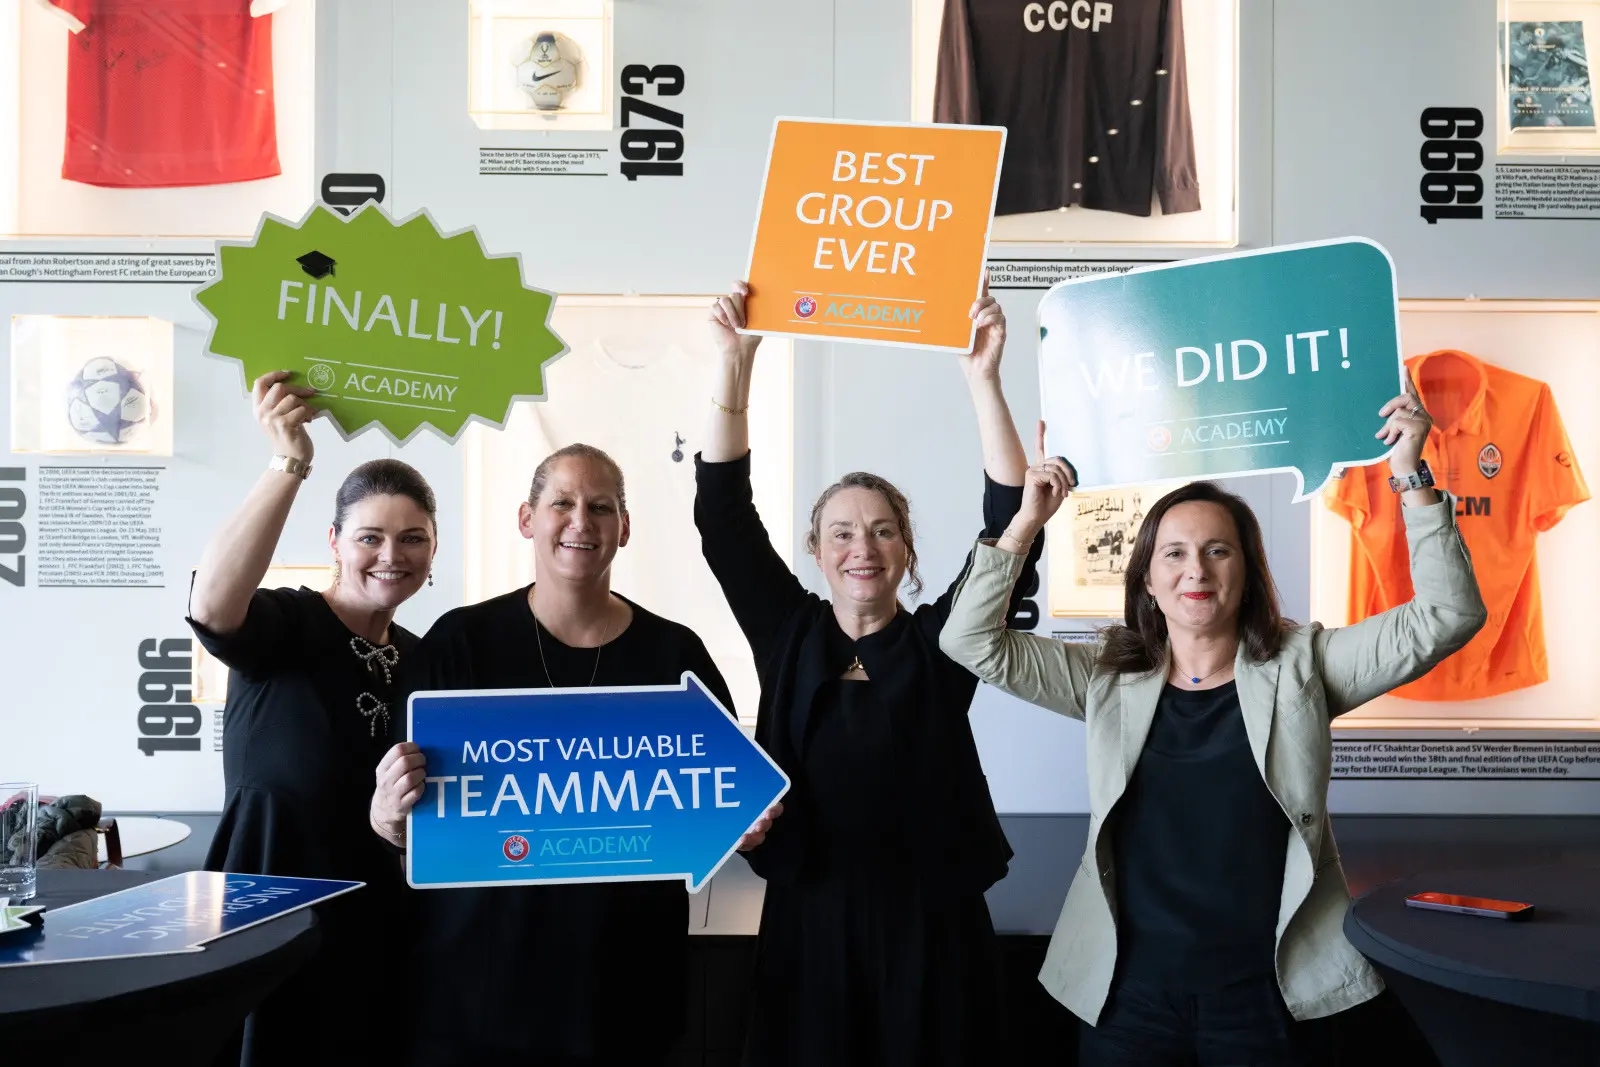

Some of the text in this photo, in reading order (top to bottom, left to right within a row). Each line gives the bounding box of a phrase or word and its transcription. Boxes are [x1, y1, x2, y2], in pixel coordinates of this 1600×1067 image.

[620, 64, 685, 181] 1973
[832, 150, 935, 186] BEST
[1420, 107, 1484, 224] 1999
[795, 192, 953, 232] GROUP
[0, 257, 11, 265] oal
[12, 257, 32, 265] from
[117, 258, 140, 267] string
[141, 258, 149, 266] of
[150, 258, 171, 268] great
[195, 259, 204, 268] by
[813, 237, 916, 276] EVER
[1006, 265, 1063, 274] Championship
[9, 268, 42, 277] Clough's
[44, 268, 92, 277] Nottingham
[169, 269, 207, 278] European
[277, 279, 503, 350] FINALLY!
[824, 302, 925, 324] ACADEMY
[1080, 351, 1159, 399] WE
[1175, 338, 1268, 388] DID
[344, 372, 458, 403] ACADEMY
[1181, 417, 1288, 446] ACADEMY
[1456, 496, 1491, 516] CM
[138, 638, 202, 756] 1996
[461, 734, 706, 764] MOST VALUABLE
[1335, 755, 1353, 763] 25th
[1355, 755, 1371, 763] club
[1373, 755, 1397, 763] would
[1398, 755, 1412, 763] win
[1413, 755, 1427, 763] the
[1429, 755, 1447, 763] 38th
[1448, 755, 1464, 763] and
[1464, 755, 1482, 763] final
[1483, 755, 1512, 763] edition
[1513, 755, 1522, 763] of
[1522, 755, 1536, 763] the
[1537, 755, 1558, 763] UEFA
[1558, 755, 1574, 765] Cup
[1553, 745, 1587, 753] Istanbul
[1333, 767, 1349, 775] way
[1350, 765, 1362, 773] for
[1363, 765, 1377, 773] the
[1378, 765, 1398, 773] UEFA
[1400, 765, 1428, 775] Europa
[1429, 765, 1460, 775] League.
[1461, 765, 1476, 773] The
[1553, 766, 1569, 775] day.
[425, 766, 741, 819] TEAMMATE
[539, 834, 652, 857] ACADEMY
